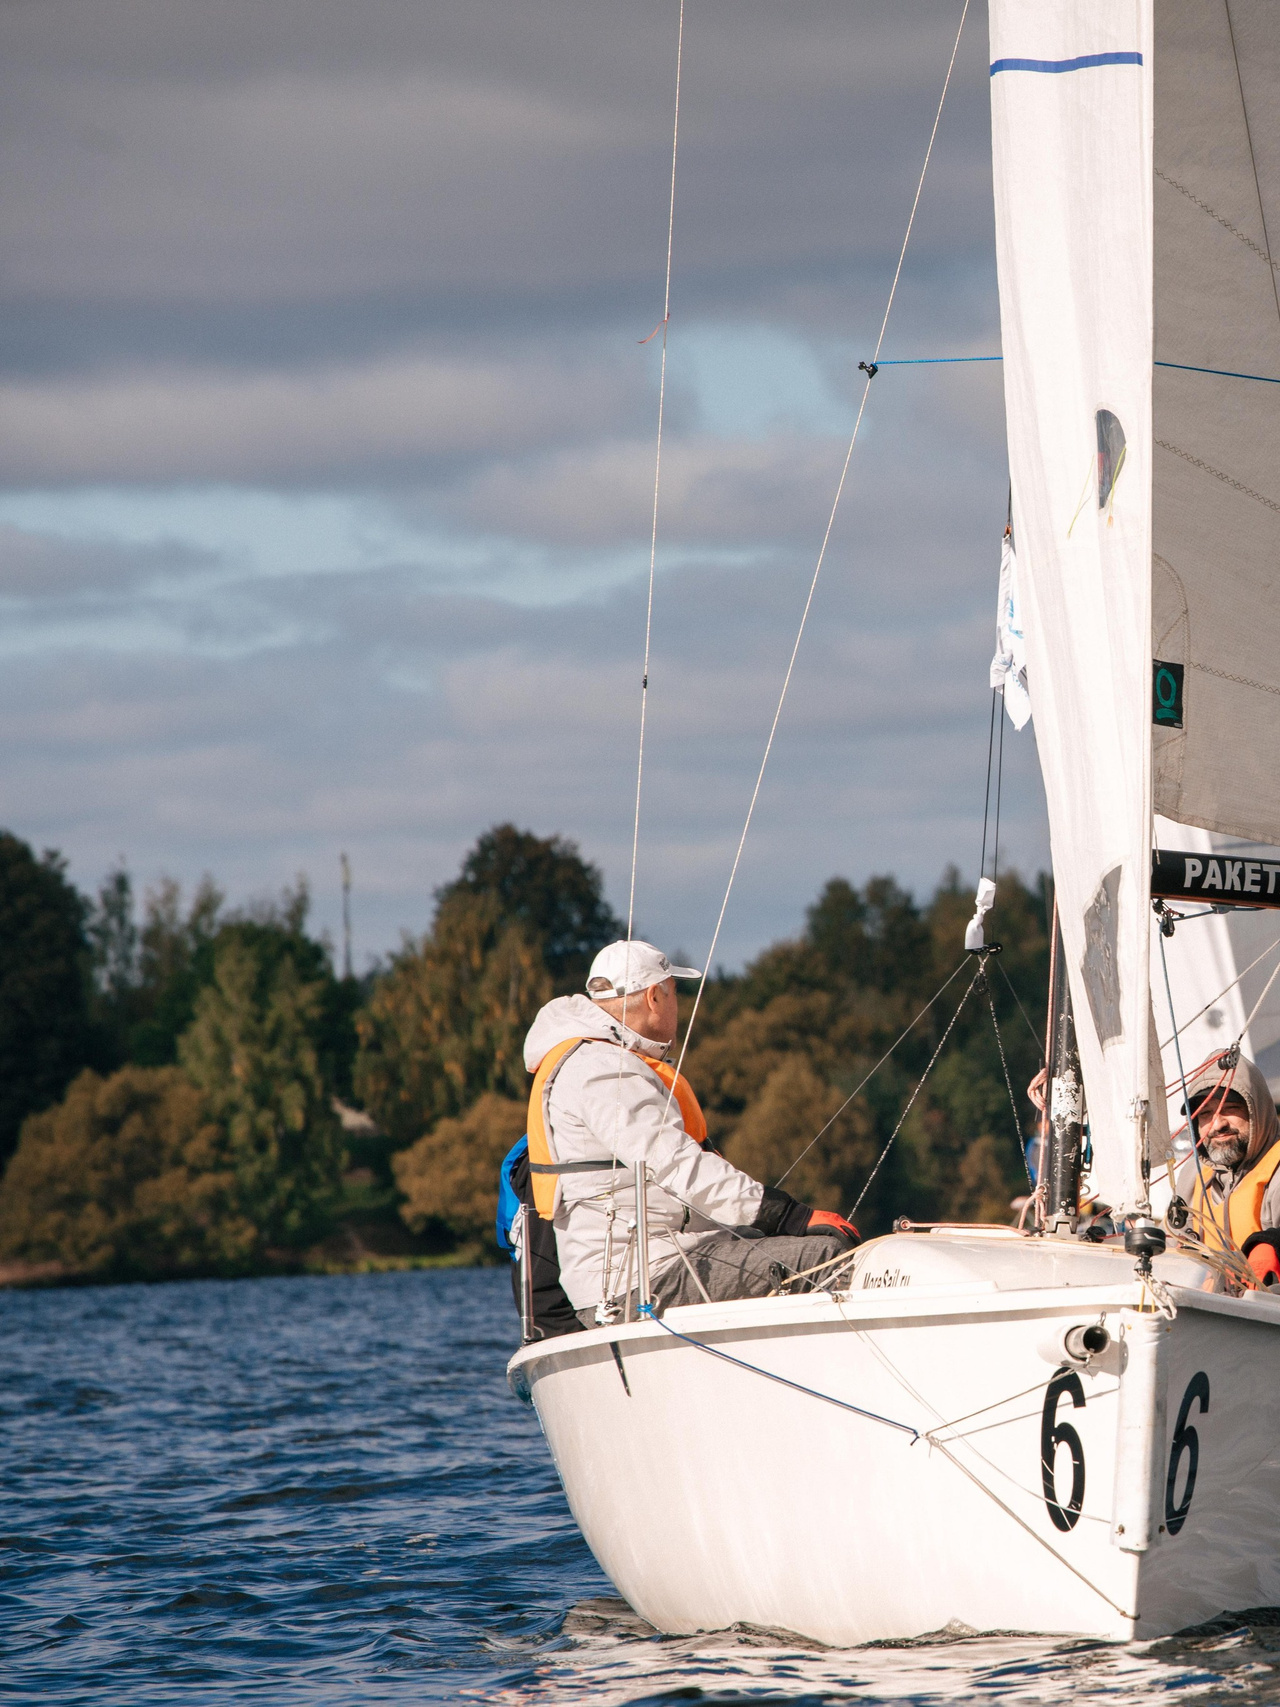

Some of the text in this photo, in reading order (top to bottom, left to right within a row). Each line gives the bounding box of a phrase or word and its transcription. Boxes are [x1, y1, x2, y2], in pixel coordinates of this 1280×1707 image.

[862, 1268, 911, 1289] MoreSailru
[1041, 1366, 1086, 1532] 6
[1165, 1371, 1210, 1535] 6
